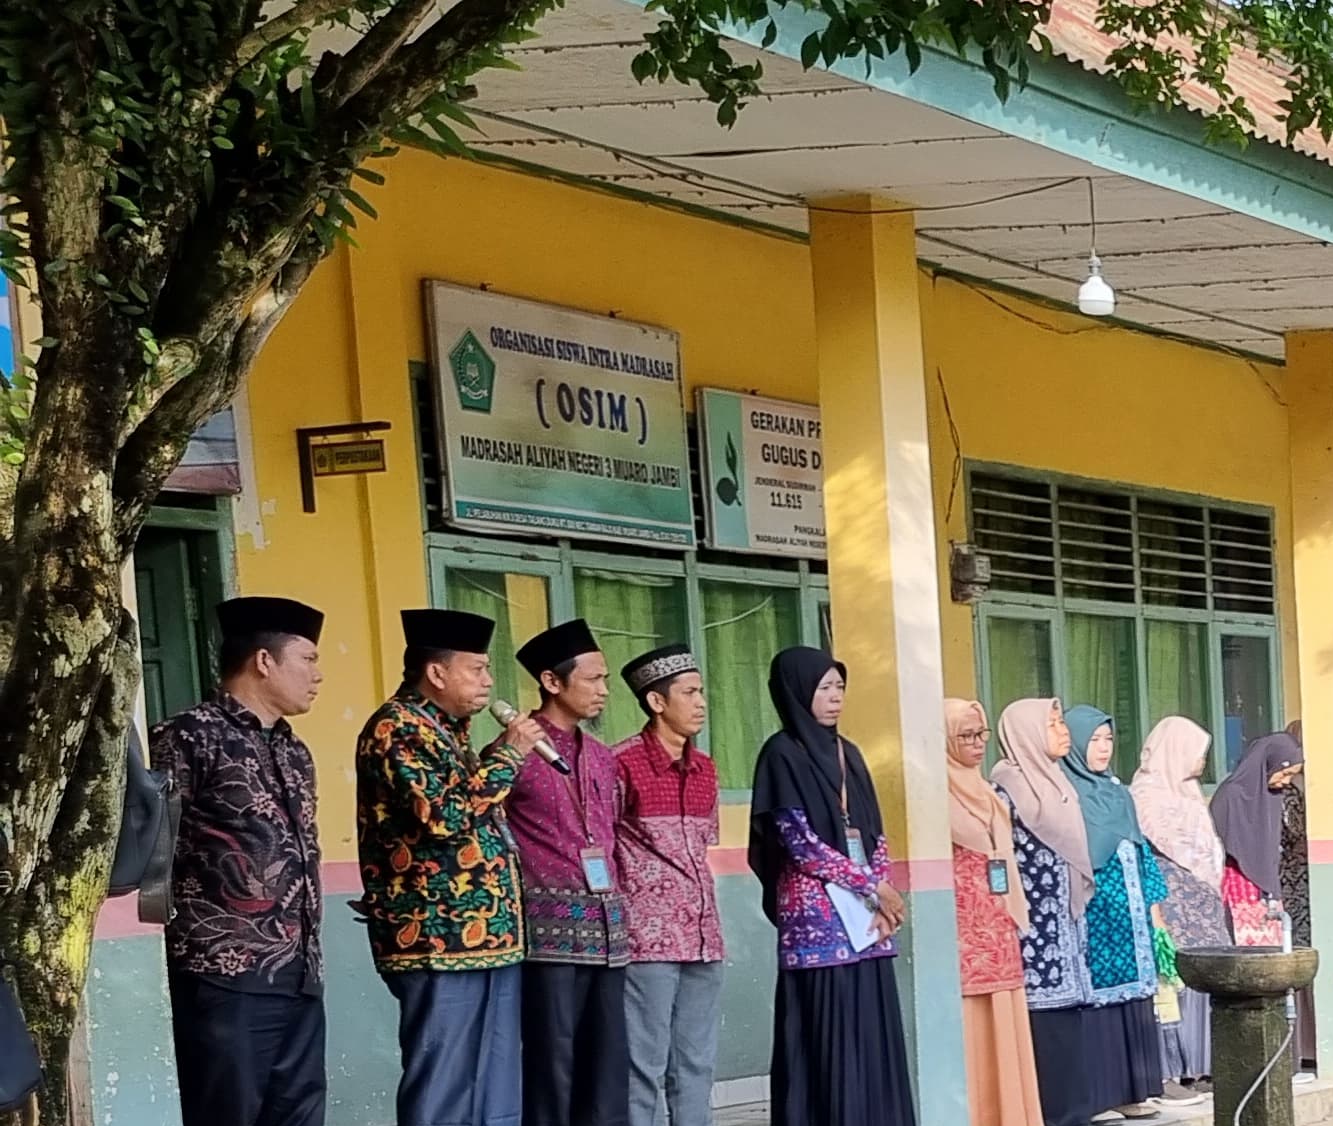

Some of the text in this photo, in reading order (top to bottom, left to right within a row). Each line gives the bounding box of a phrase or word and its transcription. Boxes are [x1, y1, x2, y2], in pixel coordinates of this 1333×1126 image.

[490, 326, 675, 381] ORGANISASI SISWA INTRA MADRASAH
[750, 411, 805, 437] GERAKAN
[461, 435, 681, 489] MADRASAH ALIYAH NEGERI 3 MUARO JAMBI
[761, 443, 808, 468] GUGUS
